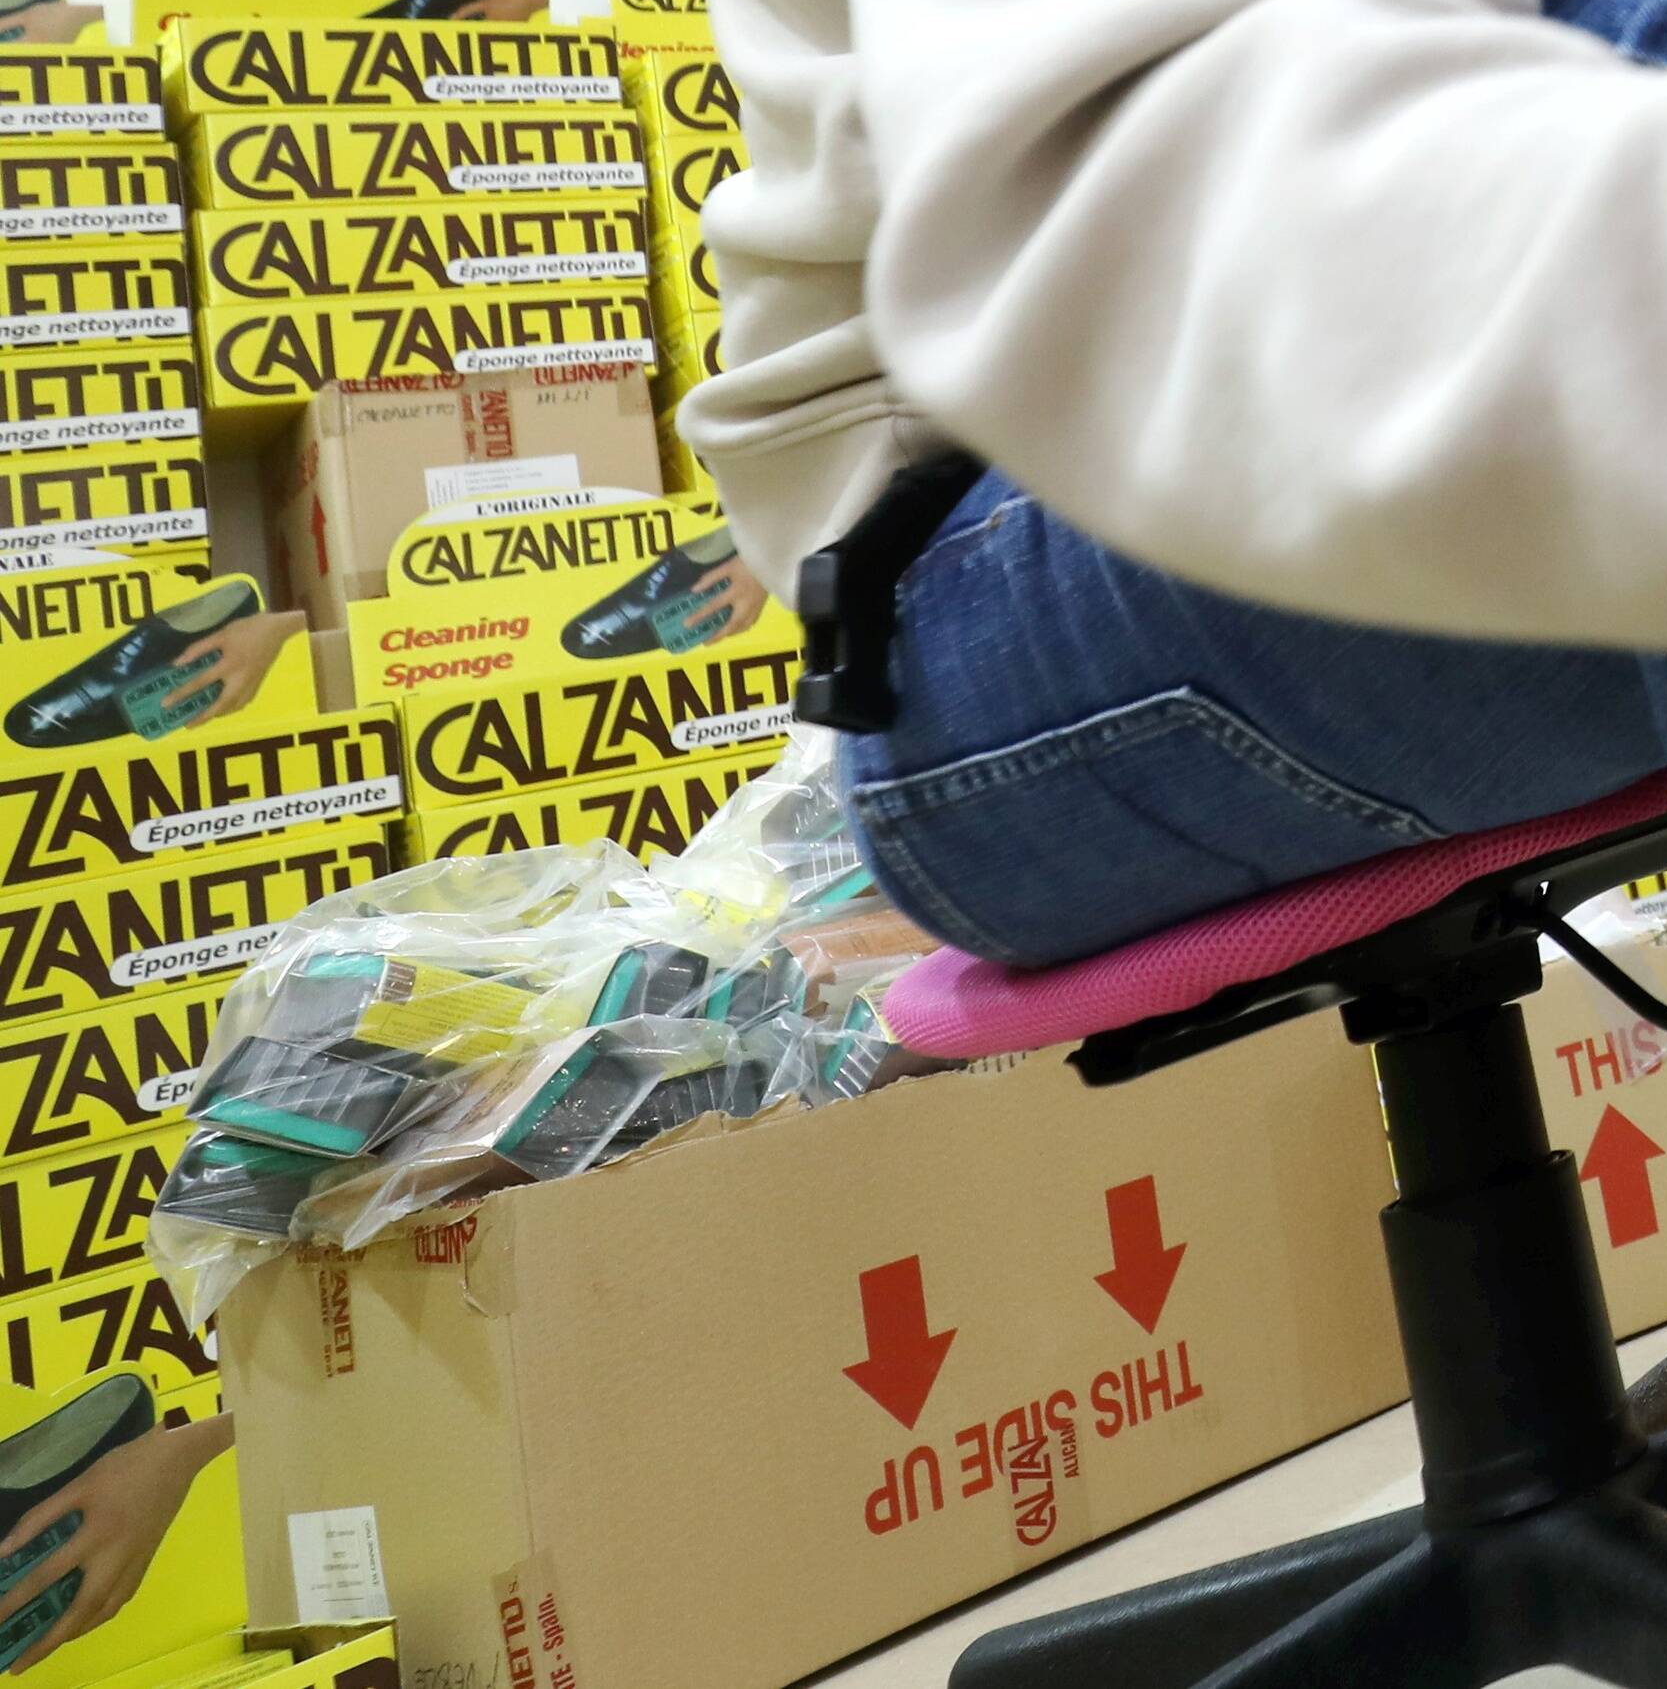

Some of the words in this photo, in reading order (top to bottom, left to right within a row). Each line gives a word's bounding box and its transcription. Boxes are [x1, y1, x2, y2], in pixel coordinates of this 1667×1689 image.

[188, 30, 618, 107] CALZANETTO
[435, 76, 505, 98] Éponge
[511, 77, 610, 99] nettoyante
[22, 108, 150, 128] nettoyante
[214, 121, 644, 201] CALZANETTO
[461, 164, 531, 187] Éponge
[536, 164, 635, 186] nettoyante
[43, 209, 169, 230] nettoyante
[209, 210, 644, 299] CALZANETTO
[459, 258, 531, 282] Éponge
[536, 255, 636, 279] nettoyante
[48, 313, 177, 336] nettoyante
[467, 348, 538, 372] Éponge
[543, 344, 644, 370] nettoyante
[0, 358, 198, 452] ETTO
[57, 415, 187, 440] nettoyante
[477, 491, 597, 517] L'ORIGINALE
[63, 516, 194, 544] nettoyante
[402, 509, 677, 587] CALZANETTO
[379, 615, 531, 655] Cleaning
[382, 649, 514, 689] Sponge
[414, 644, 806, 798] CALZANET
[684, 713, 761, 744] Éponge
[147, 811, 245, 844] Éponge
[252, 784, 388, 828] nettoyante
[127, 940, 229, 979] Éponge
[1555, 1019, 1664, 1098] THIS
[1090, 1340, 1204, 1439] THIS
[955, 1389, 1078, 1499] SIDE
[864, 1445, 945, 1536] UP
